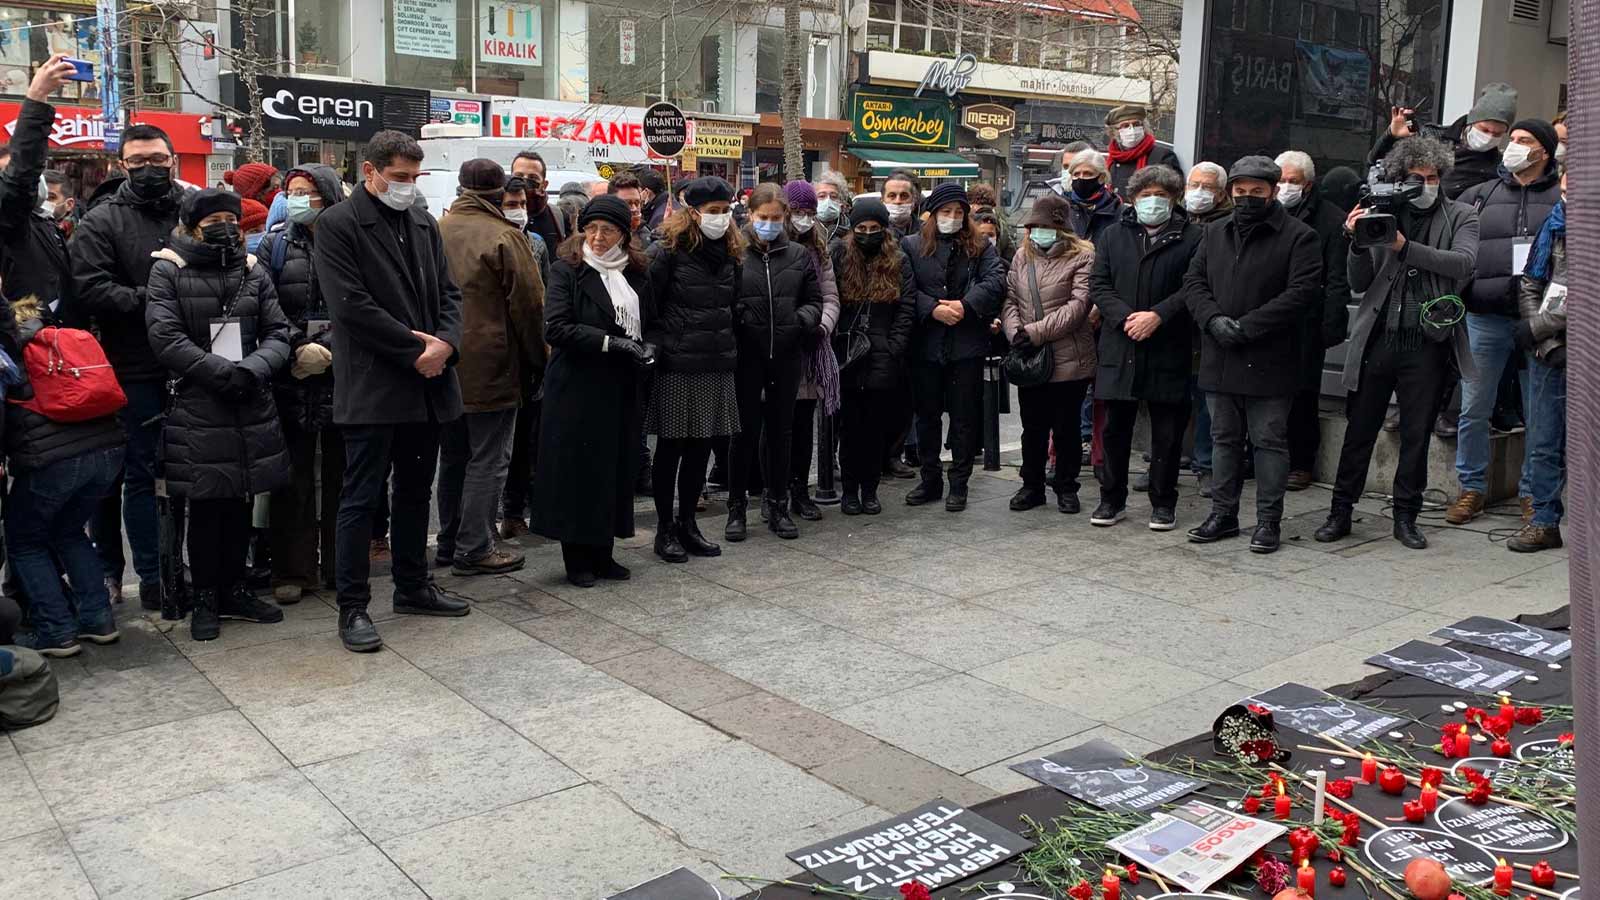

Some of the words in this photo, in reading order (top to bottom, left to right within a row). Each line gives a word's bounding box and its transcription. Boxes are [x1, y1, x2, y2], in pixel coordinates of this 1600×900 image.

[484, 38, 537, 60] KİRALIK
[914, 53, 977, 97] Mahir
[1020, 78, 1050, 92] mahir
[297, 95, 373, 119] eren
[653, 110, 675, 118] hepimiz
[312, 115, 334, 127] büyük
[337, 118, 359, 127] beden
[535, 116, 642, 147] ECZANE
[646, 118, 684, 127] HRANTIZ
[862, 110, 944, 141] Osmanbey
[711, 137, 741, 147] PAZARI
[211, 161, 230, 171] eren
[1471, 820, 1555, 844] HRANTIZ
[1474, 816, 1522, 830] hepimiz
[796, 806, 964, 869] TEFERRUATIZ
[844, 823, 966, 870] HEPİMİZ
[1195, 821, 1250, 855] AGOS
[1381, 830, 1424, 846] için!
[1506, 832, 1553, 847] hepimiz
[1385, 839, 1455, 862] ADALET
[843, 832, 988, 892] HRANT'IZ
